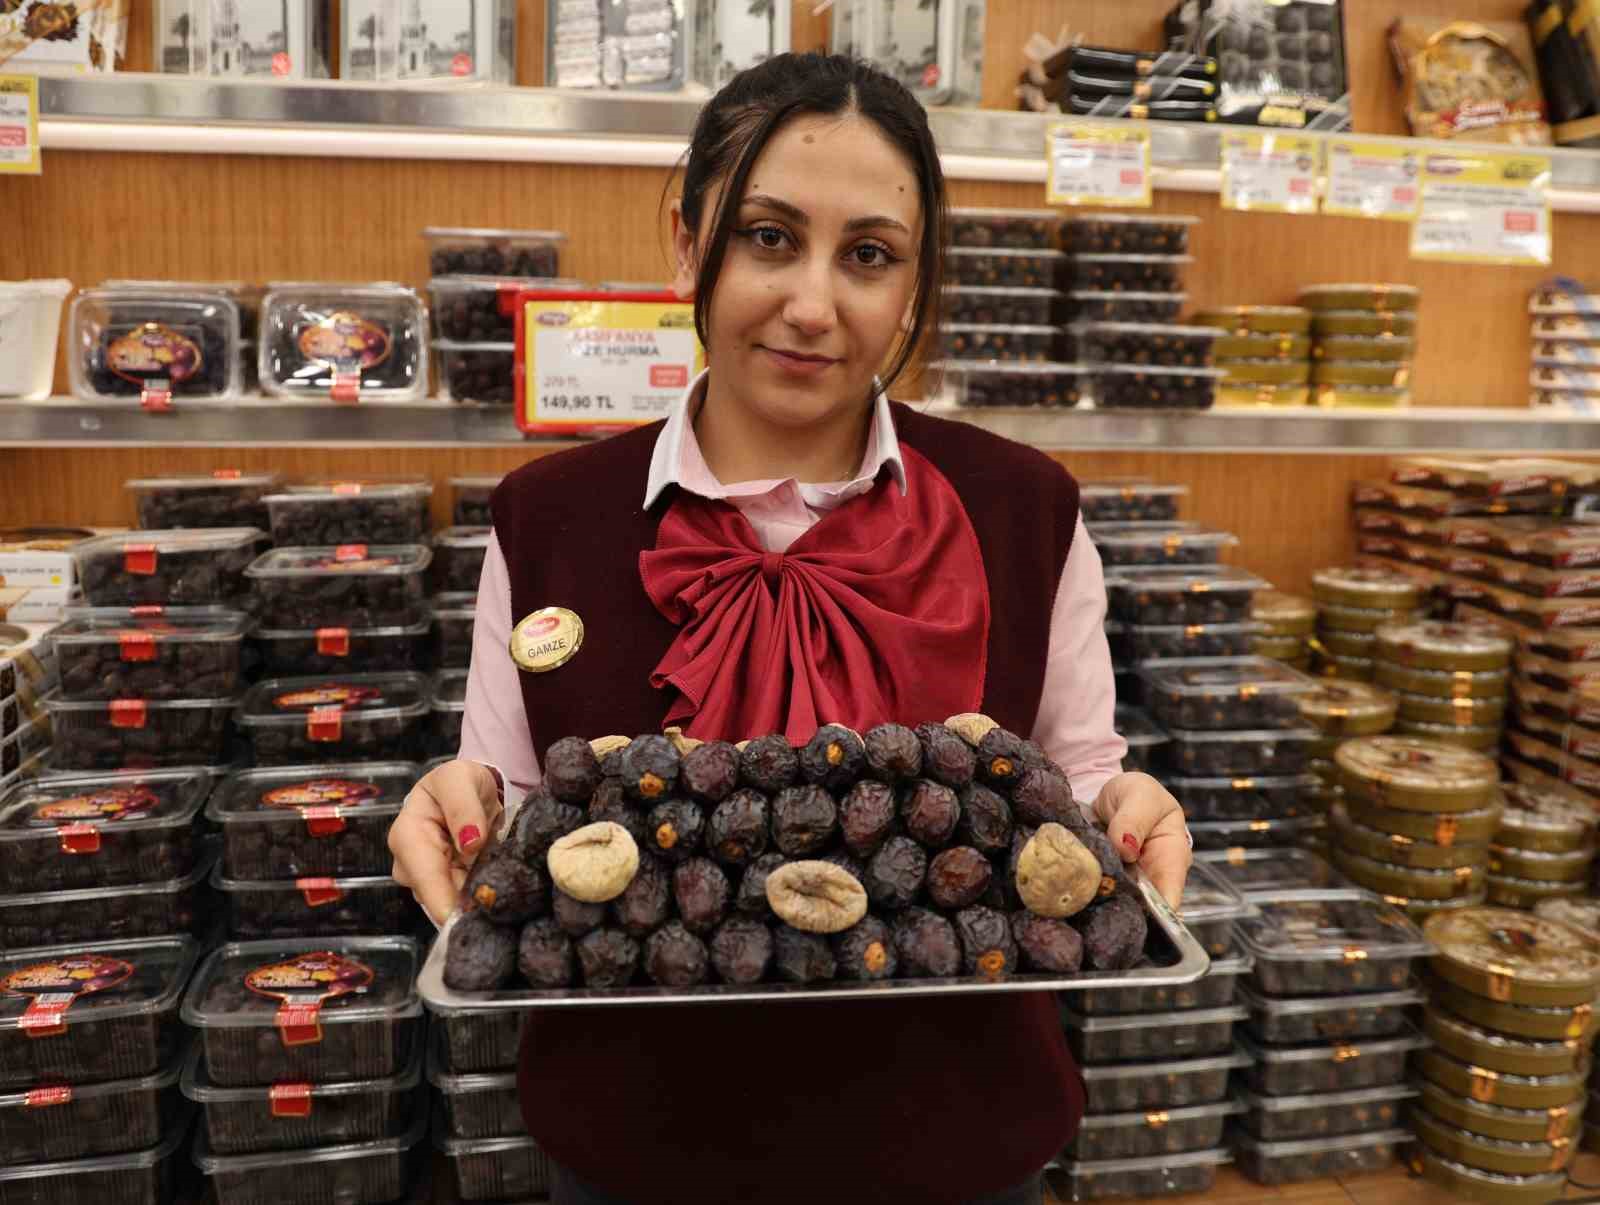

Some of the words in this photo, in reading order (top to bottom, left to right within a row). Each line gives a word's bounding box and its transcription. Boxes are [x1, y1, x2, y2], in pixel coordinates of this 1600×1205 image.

[606, 345, 660, 357] HURMA
[541, 395, 591, 412] 149,90
[596, 395, 615, 409] TL
[528, 638, 566, 657] GAMZE
